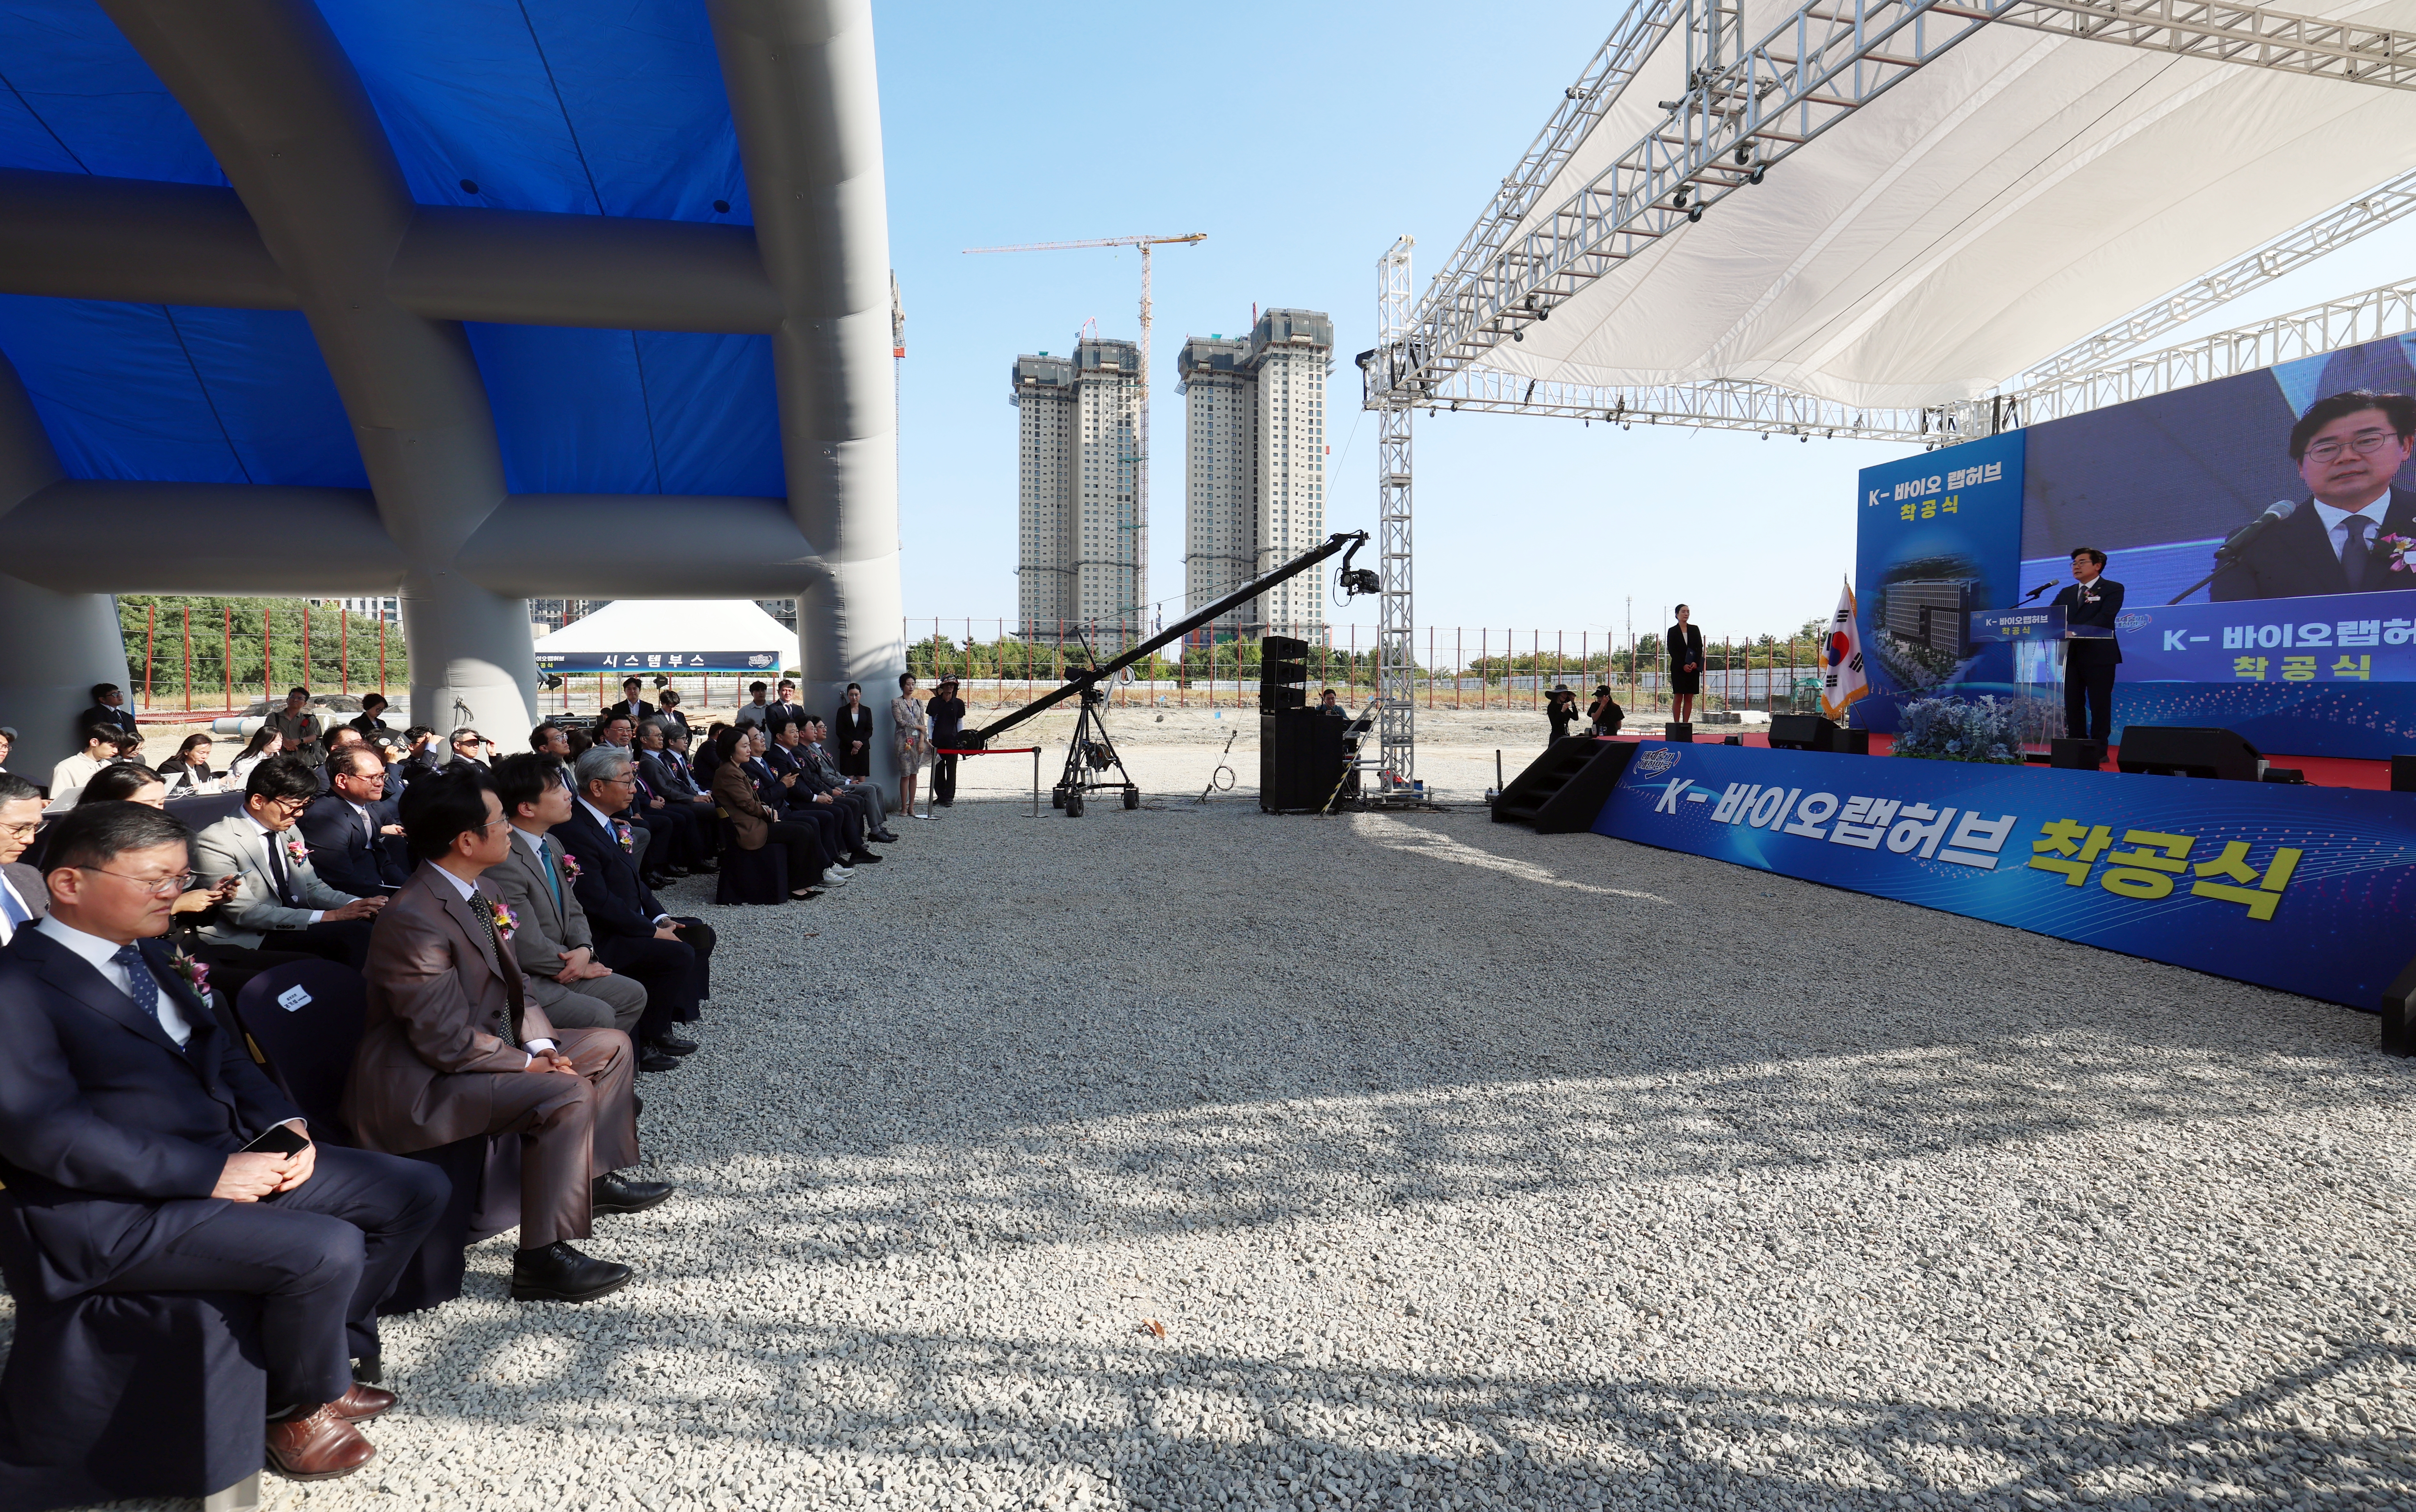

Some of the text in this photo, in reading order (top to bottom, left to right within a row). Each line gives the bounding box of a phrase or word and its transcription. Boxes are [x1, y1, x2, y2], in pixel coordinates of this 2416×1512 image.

[1869, 461, 2002, 506] K- 바이오 랩허브
[1900, 494, 1958, 521] 착공식
[1999, 615, 2048, 625] 바이오랩허브
[2163, 629, 2210, 651] K-
[603, 654, 704, 667] 시스템부스
[2233, 654, 2370, 681] 착공식
[1638, 760, 1673, 772] 대한민국
[1641, 751, 1675, 761] 대체불가
[1710, 781, 2017, 870] 바이오랩허브
[2027, 817, 2304, 921] 착공식
